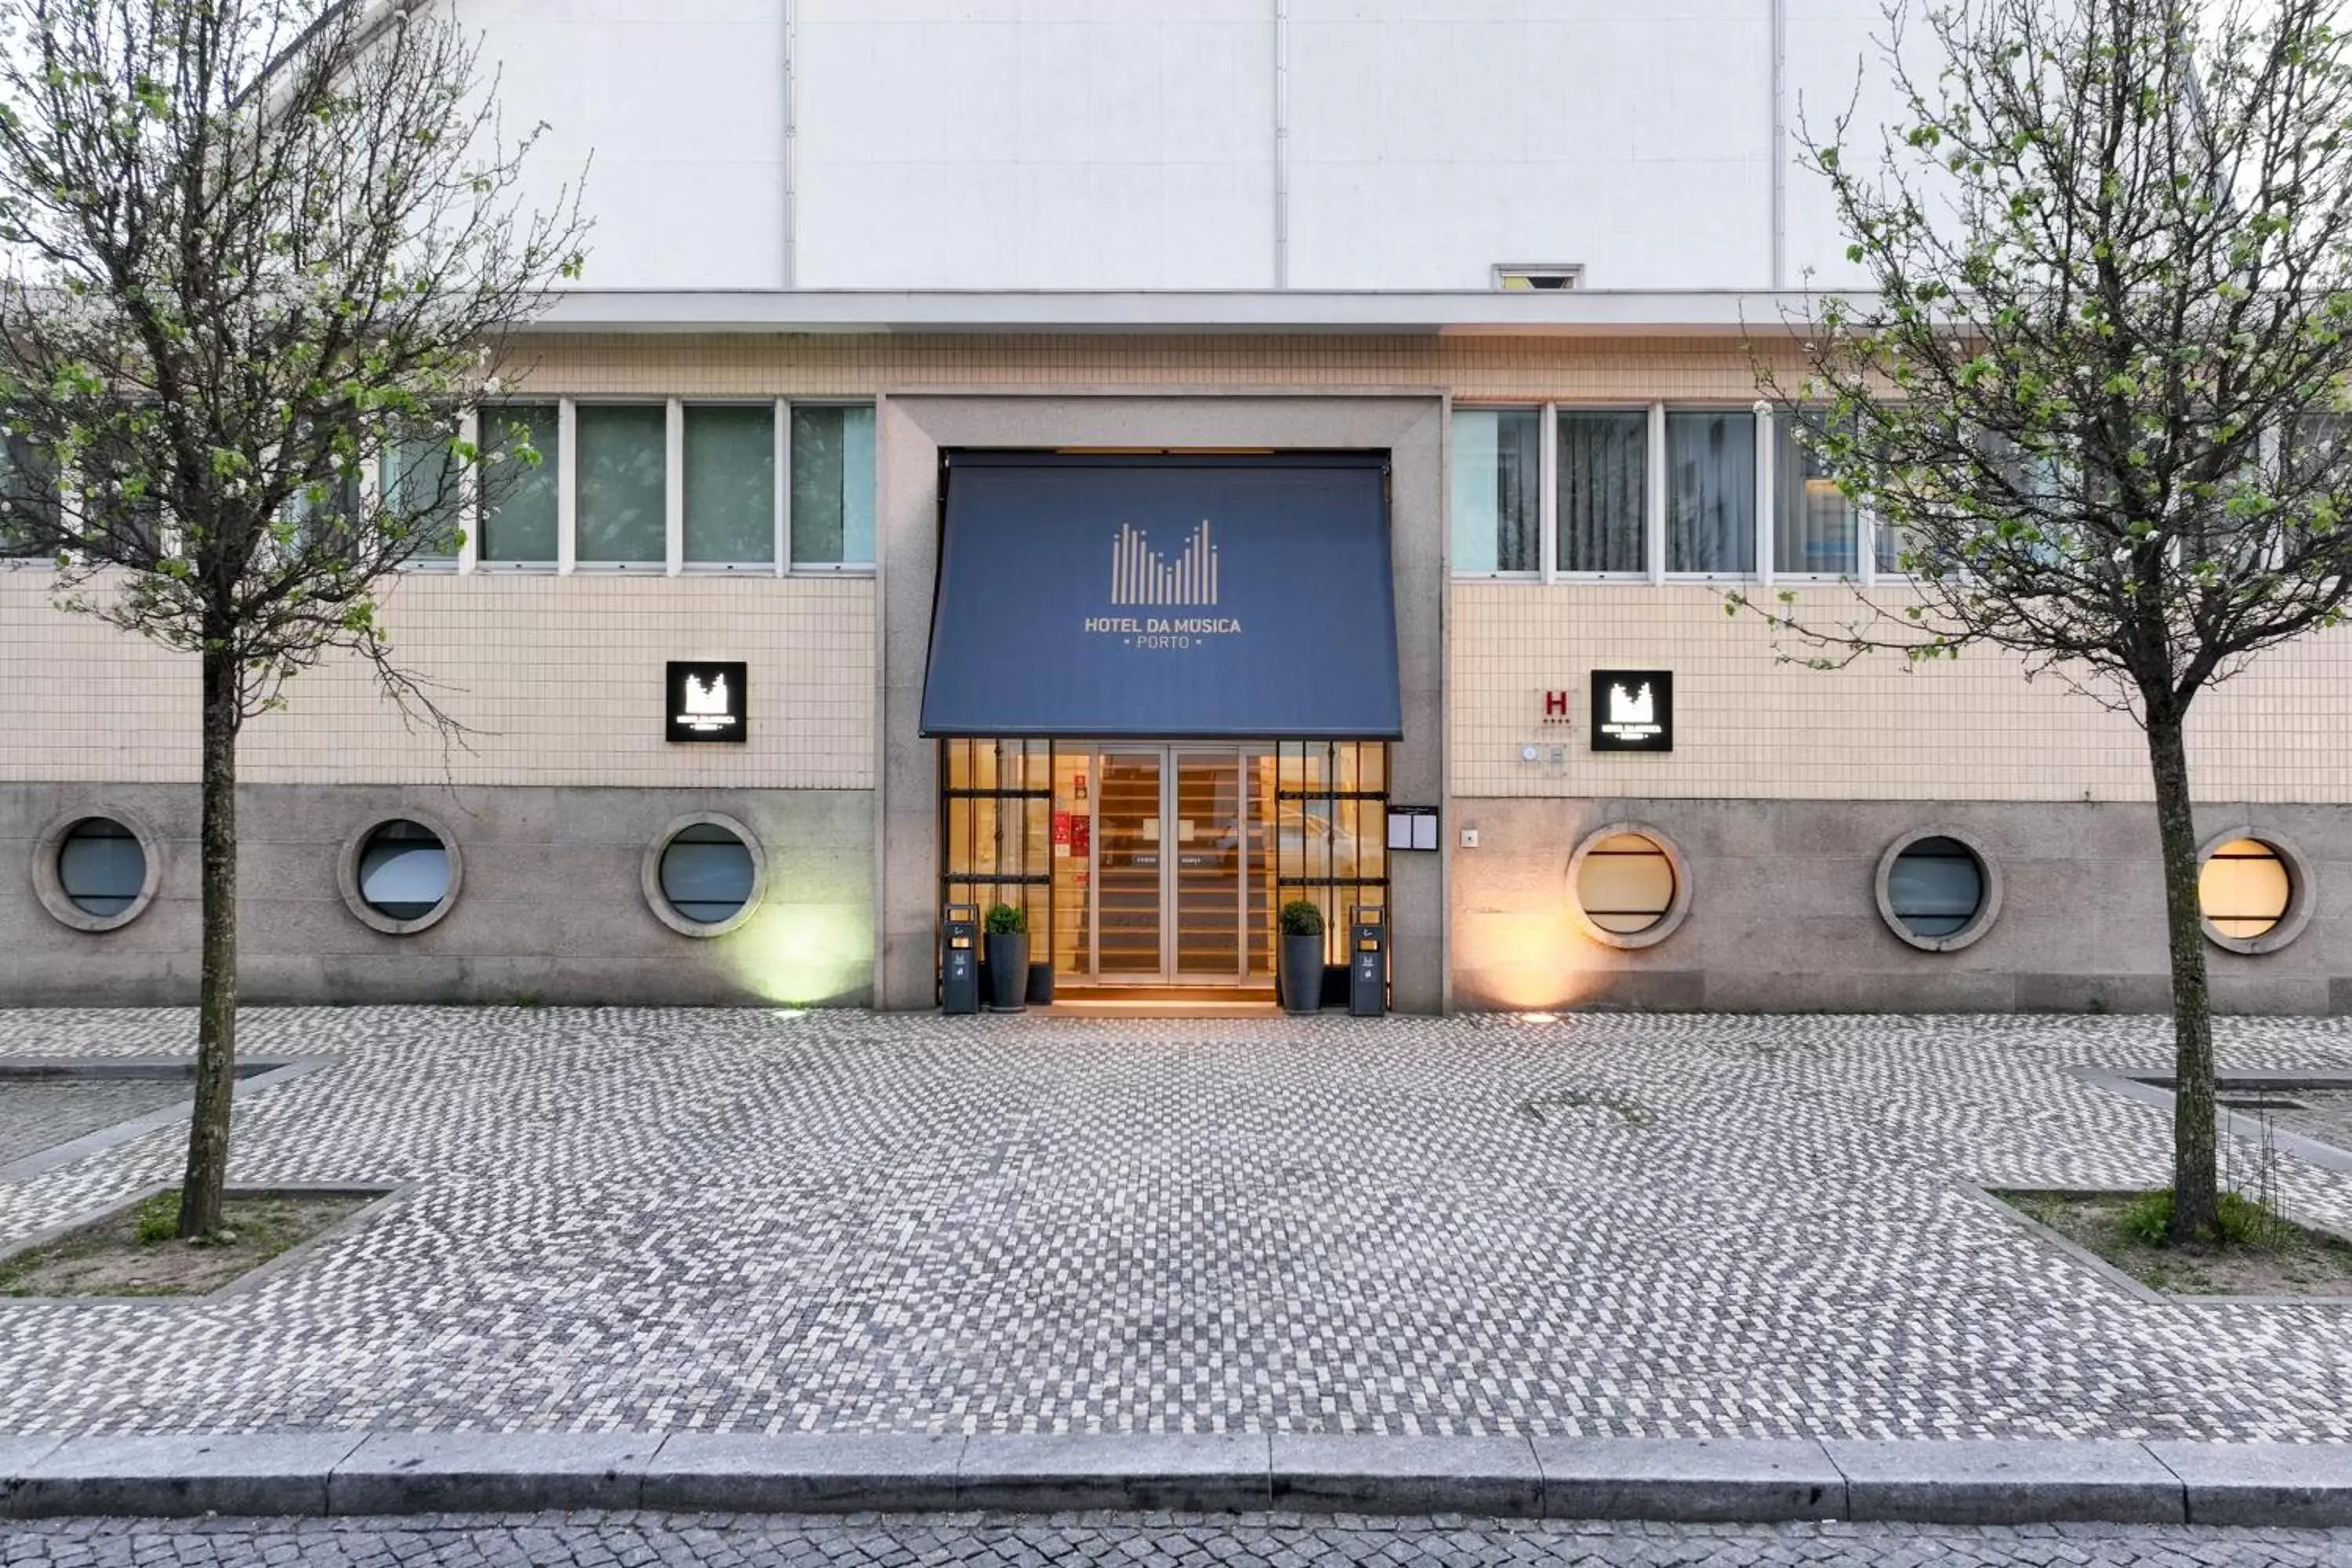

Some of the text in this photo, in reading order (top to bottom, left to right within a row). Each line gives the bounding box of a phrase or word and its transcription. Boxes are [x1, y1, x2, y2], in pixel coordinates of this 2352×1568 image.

[1084, 618, 1142, 633] HOTEL
[1147, 618, 1171, 633] DA
[1137, 636, 1189, 649] PORTO
[1545, 691, 1566, 715] H
